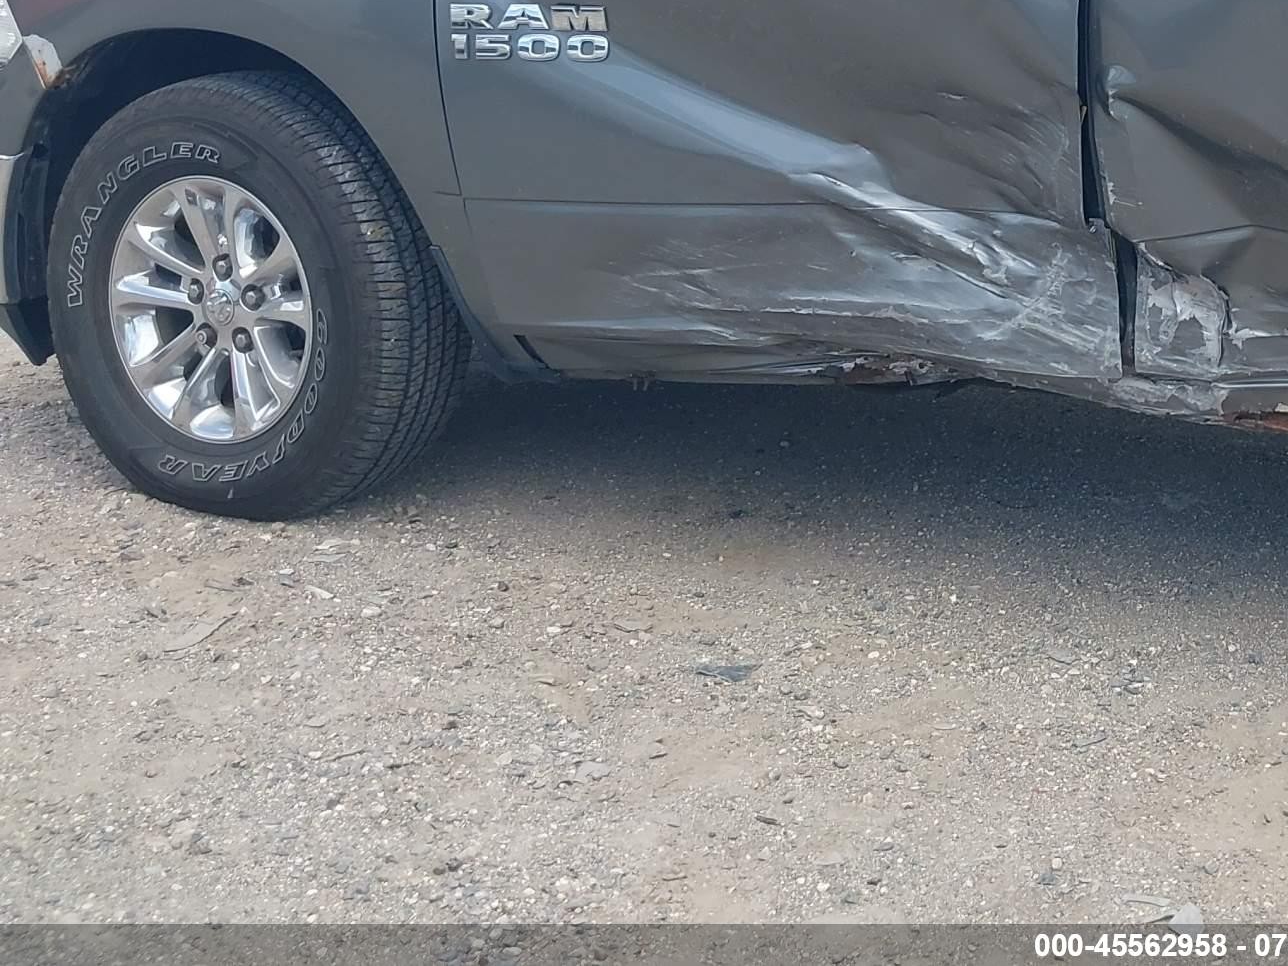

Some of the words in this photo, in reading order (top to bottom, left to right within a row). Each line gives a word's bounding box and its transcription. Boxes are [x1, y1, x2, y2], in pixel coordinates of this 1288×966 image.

[449, 2, 608, 32] RAM
[450, 33, 609, 63] 1500
[67, 142, 220, 307] WRANGLER
[157, 308, 327, 482] GOODYEAR
